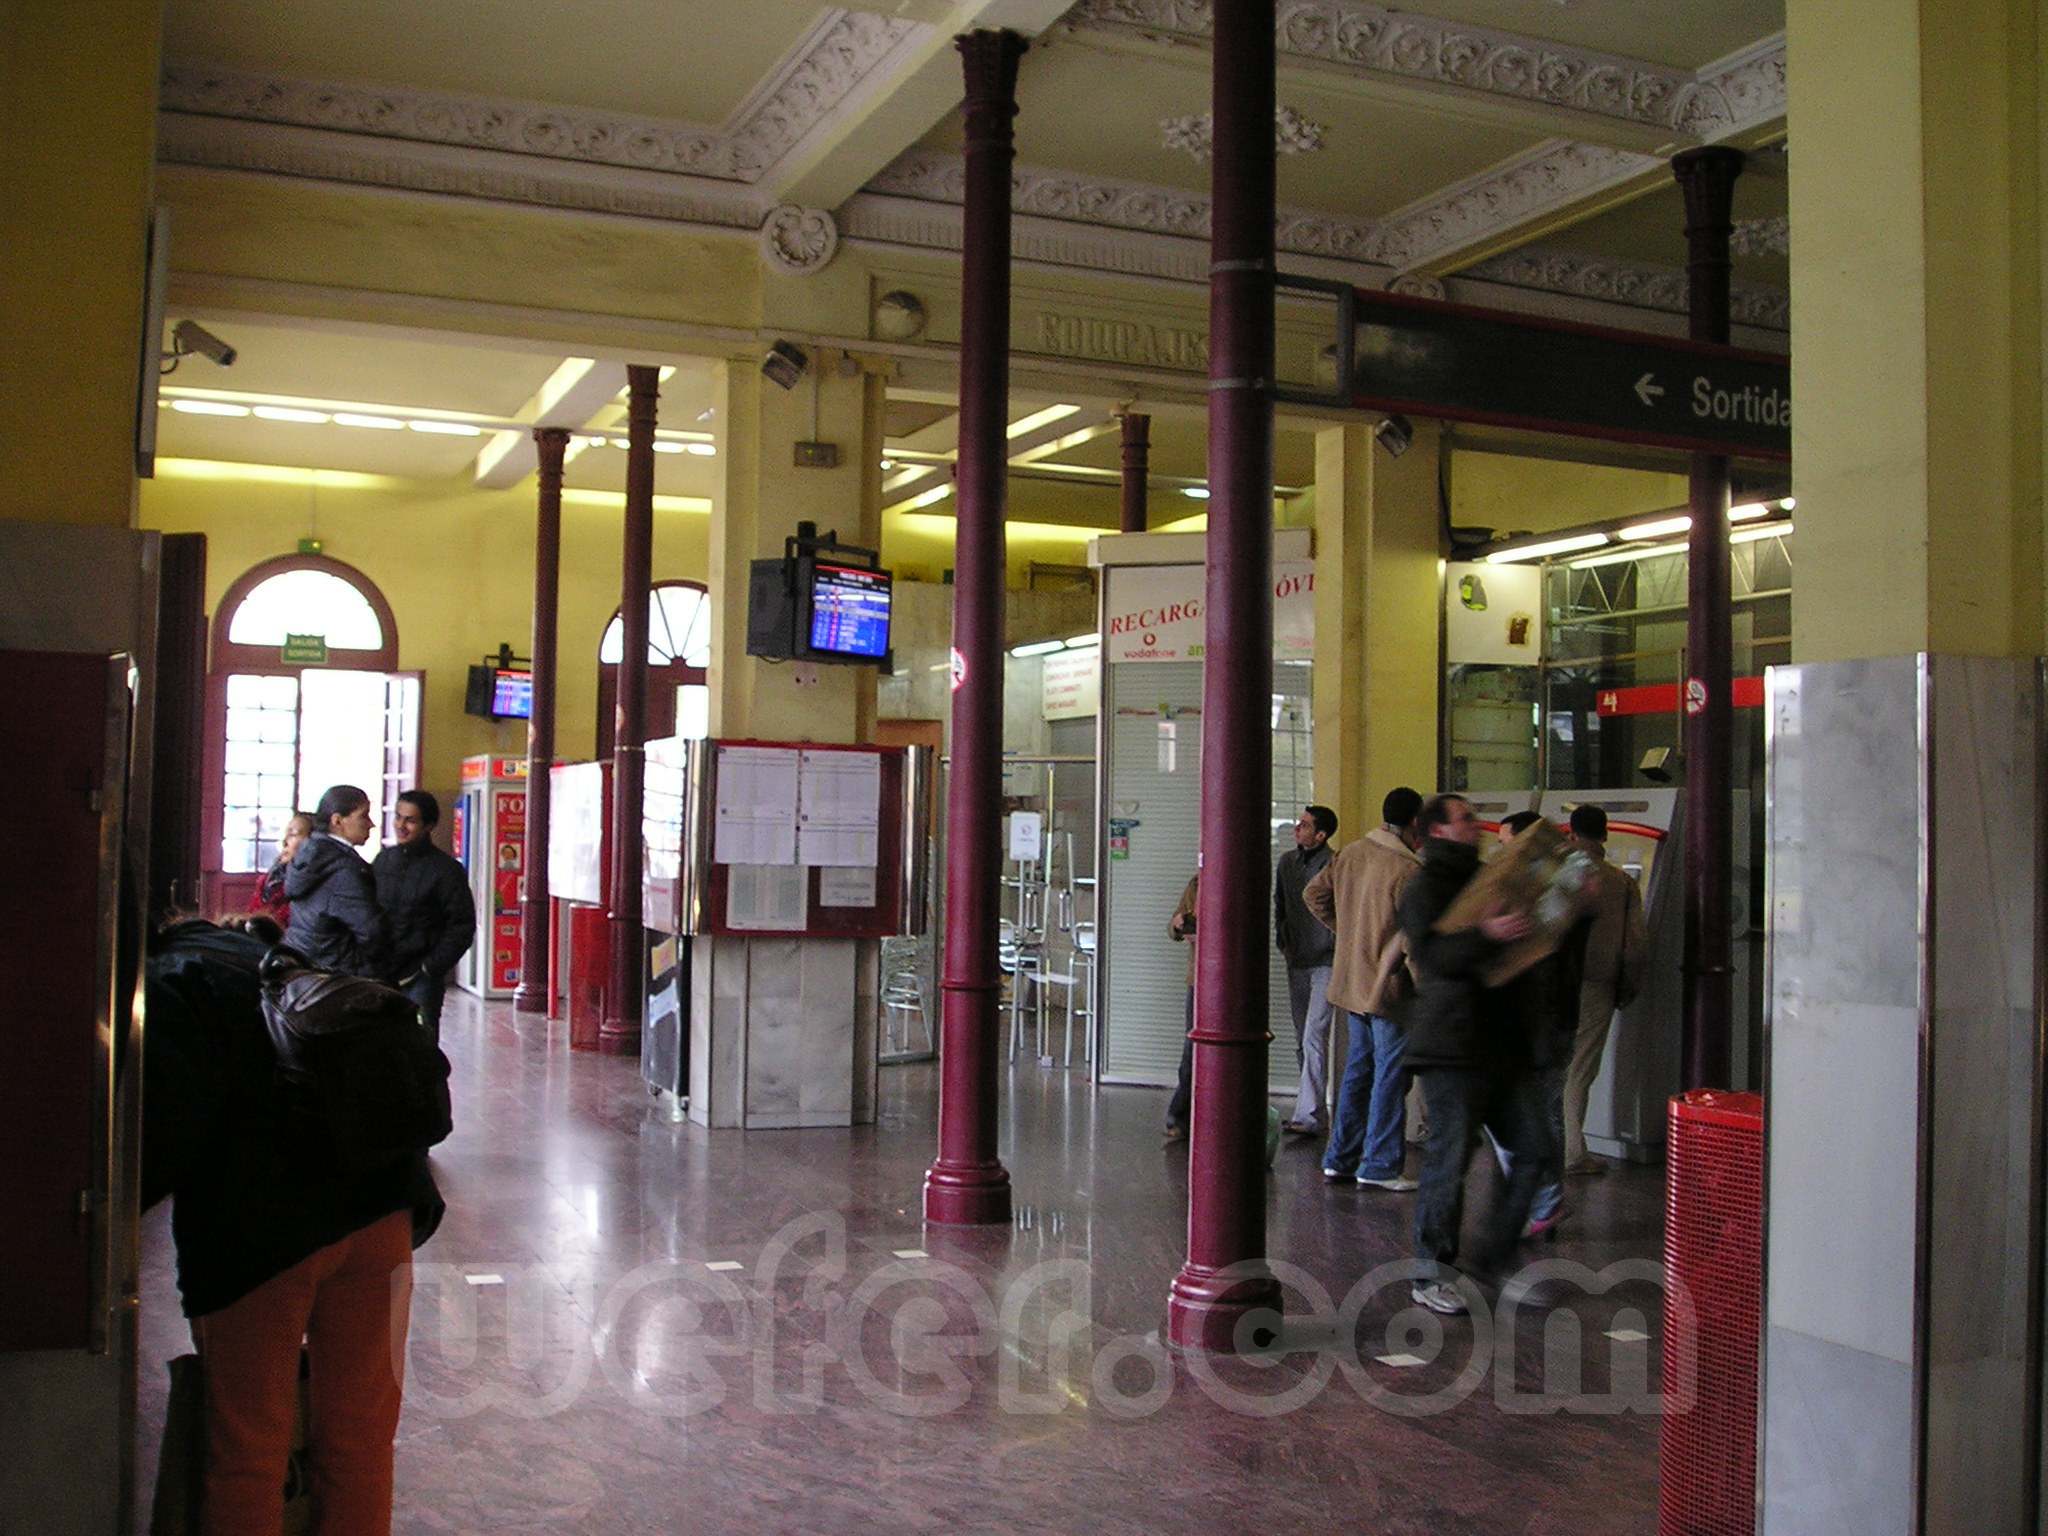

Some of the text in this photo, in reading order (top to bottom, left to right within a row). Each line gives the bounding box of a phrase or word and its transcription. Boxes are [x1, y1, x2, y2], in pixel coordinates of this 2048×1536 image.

[1692, 376, 1792, 427] Sortida
[1110, 600, 1206, 635] RECARG
[1603, 693, 1617, 712] 4
